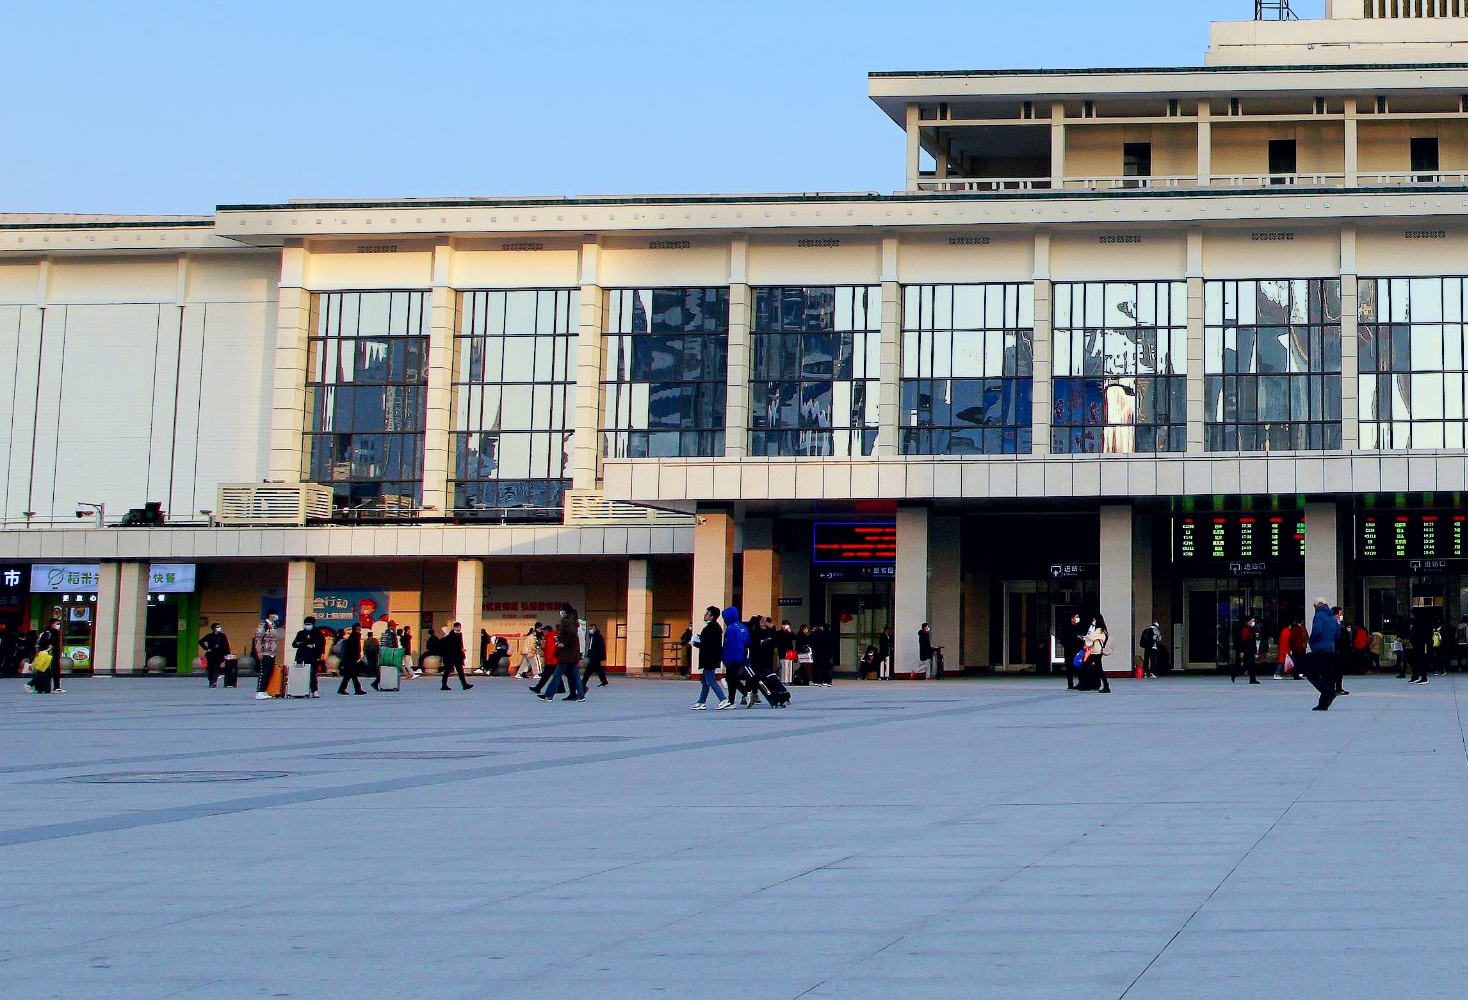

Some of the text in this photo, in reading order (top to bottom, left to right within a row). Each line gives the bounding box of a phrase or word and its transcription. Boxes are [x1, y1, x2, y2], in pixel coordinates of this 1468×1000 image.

[1244, 562, 1266, 570] 进站口
[4, 569, 21, 587] 市
[153, 572, 176, 585] 快餐
